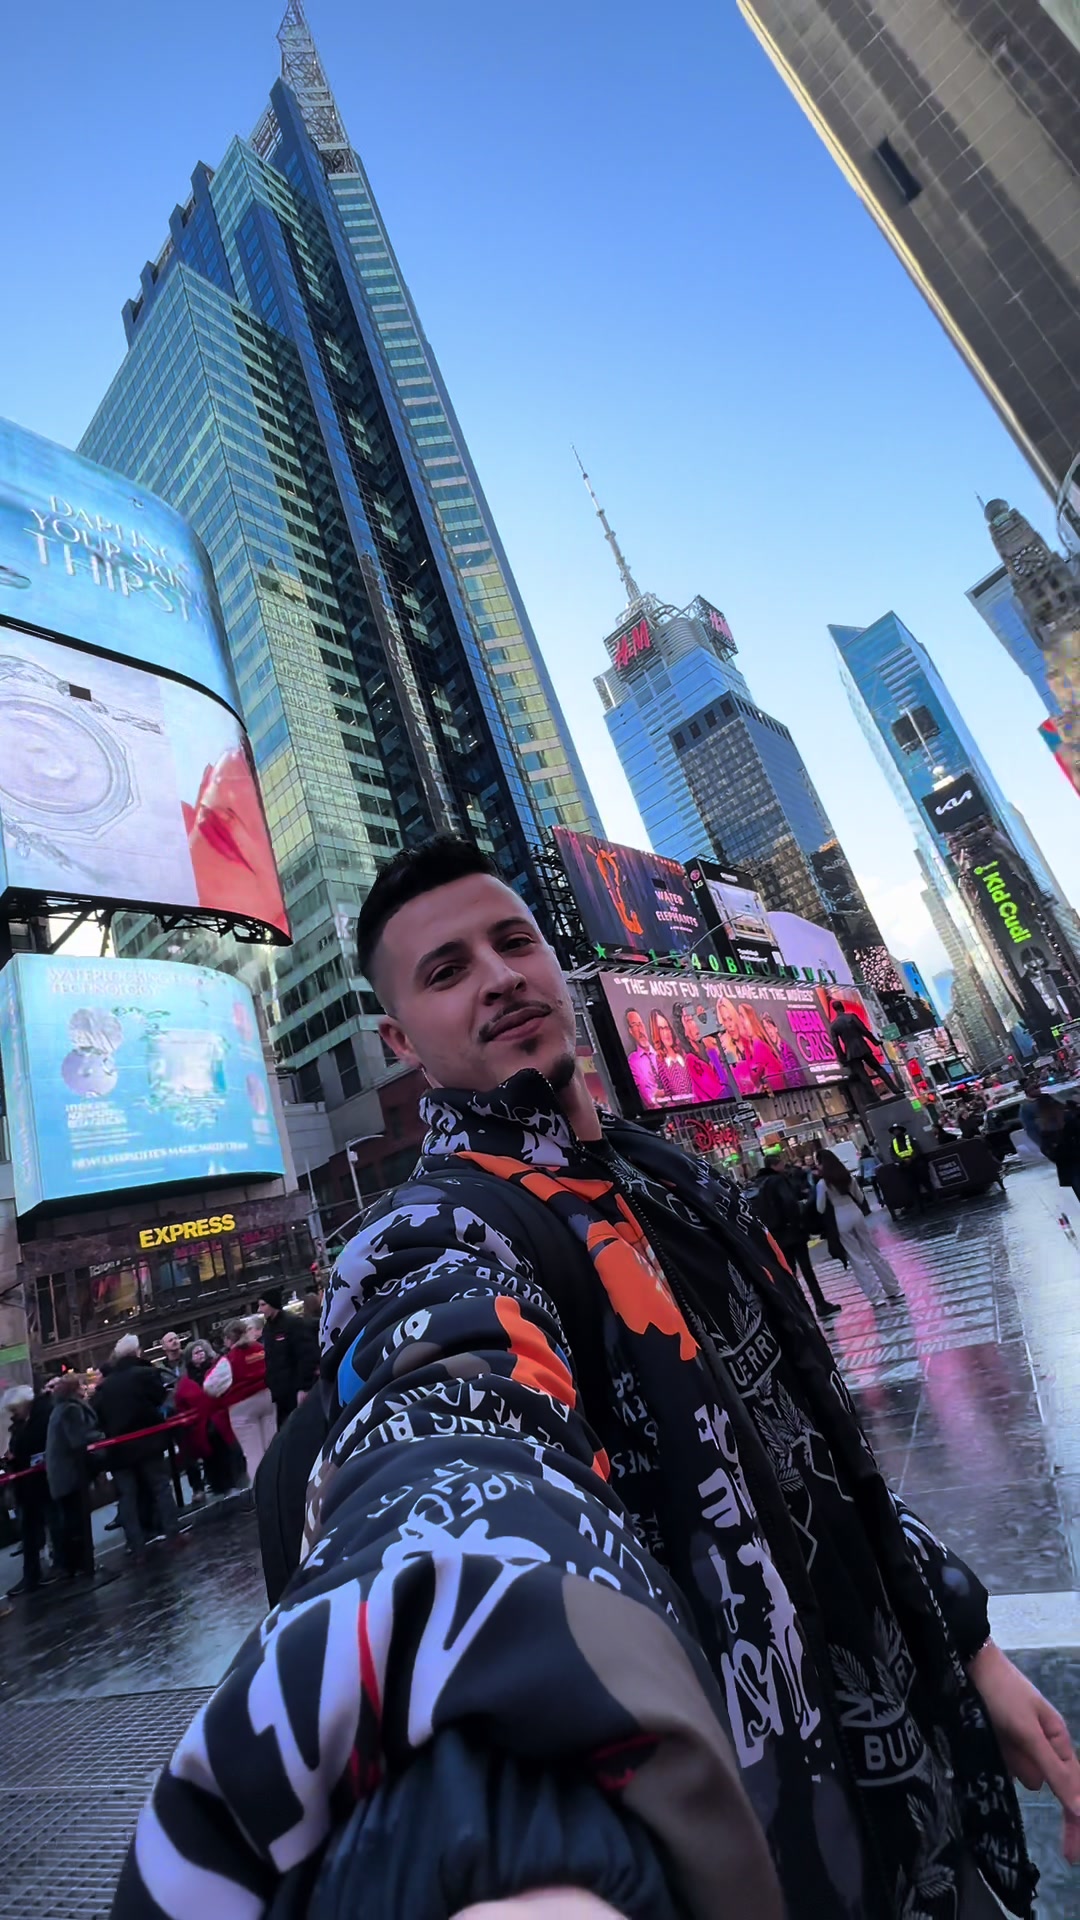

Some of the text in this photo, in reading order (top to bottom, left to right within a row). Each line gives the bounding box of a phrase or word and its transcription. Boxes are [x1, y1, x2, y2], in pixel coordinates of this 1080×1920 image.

[132, 552, 192, 597] SKIN
[655, 890, 684, 905] WATER
[694, 880, 704, 889] LG
[655, 911, 699, 927] ELEPHANTS
[983, 871, 1032, 943] Kid Cudi
[648, 948, 838, 984] 1540 BROADWAY
[649, 980, 680, 997] MOST
[701, 982, 737, 999] YOU'LL
[758, 986, 769, 1000] AT
[786, 1010, 827, 1032] MEAN
[796, 1031, 838, 1062] GIRLS
[138, 1213, 236, 1249] EXPRESS
